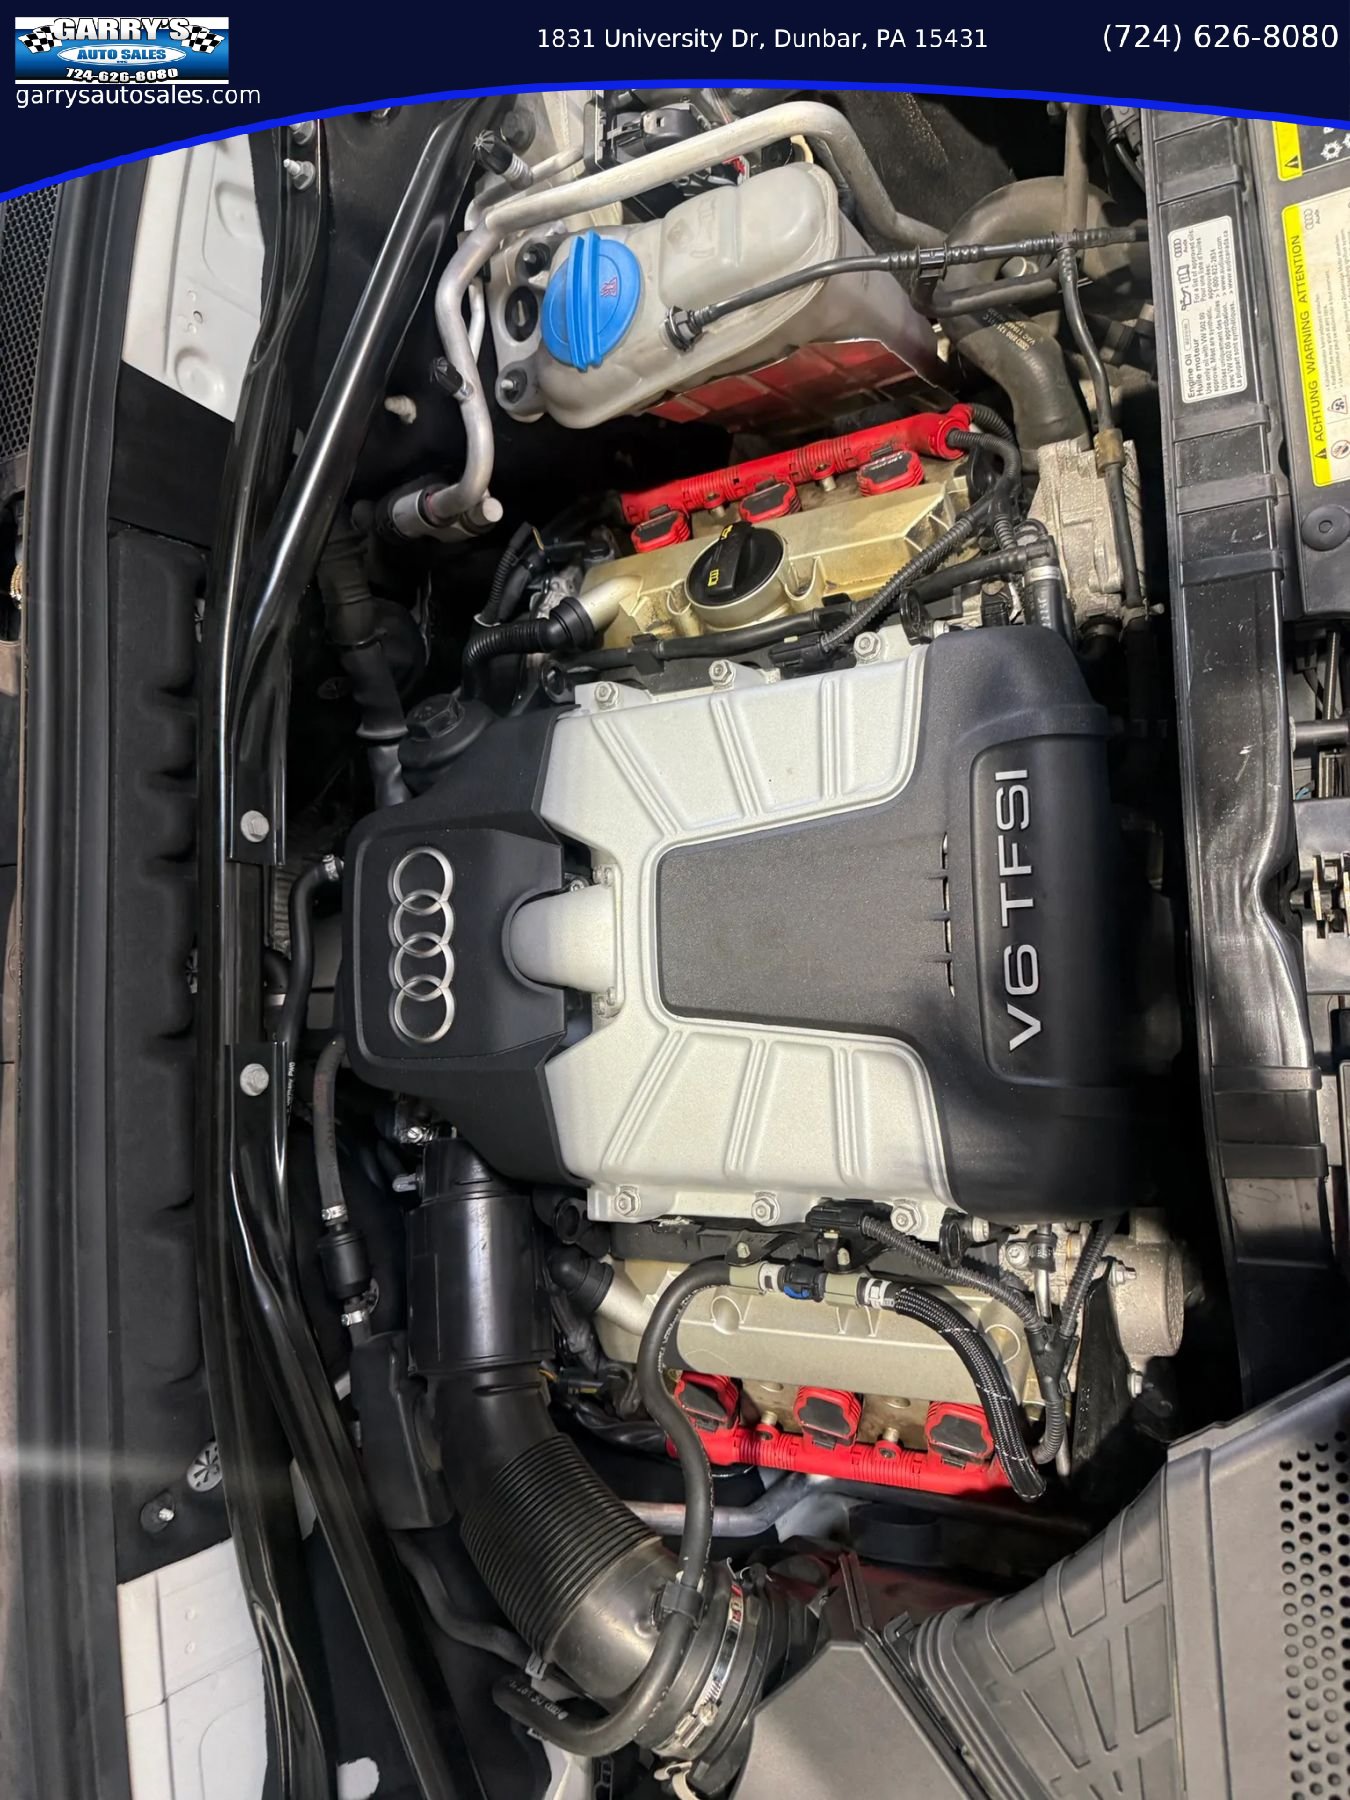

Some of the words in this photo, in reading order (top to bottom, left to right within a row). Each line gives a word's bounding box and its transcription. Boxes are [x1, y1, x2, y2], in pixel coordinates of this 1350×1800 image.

[1189, 241, 1197, 269] approved
[1290, 234, 1307, 304] ATTENTION
[1192, 337, 1201, 371] moteur
[1200, 332, 1207, 344] VW
[1299, 309, 1316, 374] WARNING
[1184, 353, 1192, 366] Oil
[1227, 361, 1233, 373] VW
[1185, 367, 1196, 398] Engine
[1195, 373, 1203, 396] Huile
[1307, 379, 1324, 443] ACHTUNG
[994, 769, 1034, 927] TFSI
[1003, 943, 1042, 1051] V6
